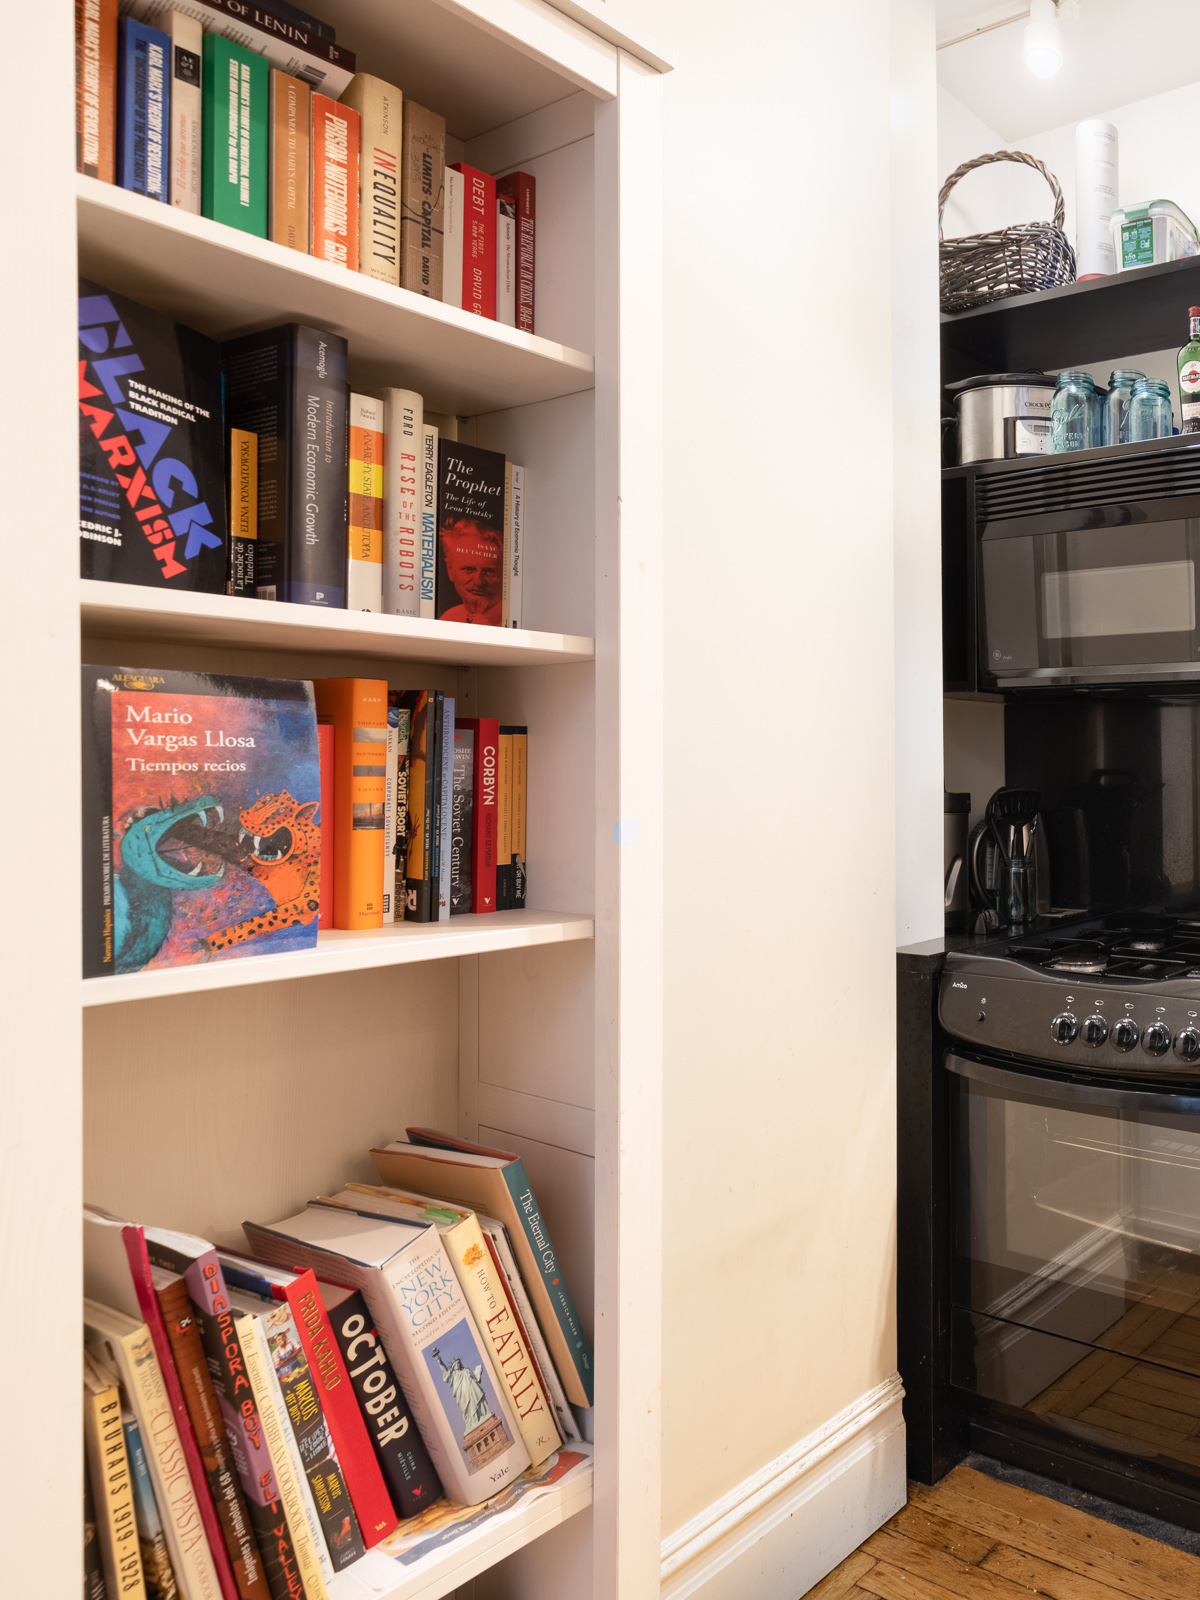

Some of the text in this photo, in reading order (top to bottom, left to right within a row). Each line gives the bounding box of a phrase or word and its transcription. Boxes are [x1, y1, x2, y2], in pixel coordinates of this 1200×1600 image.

[84, 18, 101, 60] MARX'S
[228, 0, 248, 16] OF
[255, 10, 308, 44] LENIN
[147, 43, 163, 68] KARL
[84, 56, 101, 97] THEORY
[147, 66, 163, 102] MARX'S
[84, 91, 100, 110] OF
[147, 98, 162, 134] THEORY
[146, 130, 161, 146] OF
[288, 137, 297, 150] TO
[324, 112, 348, 237] PRISON NOTEBOOKS
[373, 147, 397, 265] INEQUALITY
[472, 177, 485, 215] DEBT
[420, 152, 433, 286] LIMITS CAPITAL DAVID
[520, 216, 533, 235] THE
[520, 231, 533, 271] REPUBLIC
[473, 267, 483, 300] DAVID
[520, 268, 533, 281] IN
[316, 341, 327, 379] Acemoglu
[128, 378, 210, 419] THE MAKING OF THE
[129, 389, 197, 423] BLACK RADICAL
[129, 400, 178, 426] TRADITION
[324, 400, 334, 463] Introduction to
[403, 407, 413, 437] FORD
[305, 394, 320, 546] Modern Economic Growth
[400, 452, 416, 496] RISE
[423, 433, 434, 508] TERRY EAGLETON
[444, 472, 502, 497] Prophet
[446, 457, 474, 476] The
[240, 440, 250, 534] ELENA PONIATOWSKA
[402, 501, 414, 509] OF
[445, 492, 487, 508] The Life of
[398, 511, 416, 522] THE
[444, 502, 494, 520] Leon Trotsky
[361, 526, 372, 559] UTOPIA
[398, 526, 415, 592] ROBOTS
[421, 512, 434, 600] MATERIALISM
[456, 547, 498, 560] DEUTSCHER
[477, 543, 498, 551] ISAAC
[235, 542, 244, 591] La noche de
[245, 543, 255, 586] Tlatelolco
[112, 673, 165, 684] ALFAGUARA
[126, 704, 193, 724] Mario
[127, 728, 256, 751] Vargas Llosa
[126, 757, 246, 775] Tiempos recios
[483, 745, 496, 806] CORBYN
[396, 770, 408, 838] SOVIET SPORT
[451, 764, 466, 888] The Soviet Century
[514, 889, 523, 899] ME
[519, 1188, 557, 1274] The Eternal City
[391, 1247, 442, 1289] ENCYCLOPEDIA OF
[400, 1257, 442, 1300] NEW
[408, 1255, 421, 1266] THE
[401, 1269, 453, 1315] YORK
[411, 1285, 454, 1327] CITY
[476, 1267, 498, 1310] HOW TO
[411, 1298, 461, 1338] SECOND EDITION
[557, 1291, 578, 1337] JESSICA MAIER
[298, 1290, 341, 1391] FRIDA KAHLO
[340, 1312, 410, 1449] OCTOBER
[485, 1305, 546, 1422] EATALY
[293, 1378, 319, 1421] MARCUS
[101, 1401, 128, 1496] BAUHAUS
[202, 1264, 249, 1395] DIASPORA
[241, 1399, 261, 1450] BOY
[261, 1470, 279, 1515] ELI
[272, 1524, 302, 1600] VALLEY
[241, 1329, 306, 1533] The Essential CARIBBEAN COOKBOOK
[219, 1471, 232, 1487] 68
[397, 1452, 411, 1481] MIÉVILLE
[406, 1451, 417, 1472] CHINA
[489, 1465, 511, 1484] Yale
[150, 1410, 204, 1554] CLASSIC PASTA
[221, 1487, 237, 1504] del
[326, 1472, 342, 1500] MARCUS
[241, 1540, 259, 1586] Imágenes
